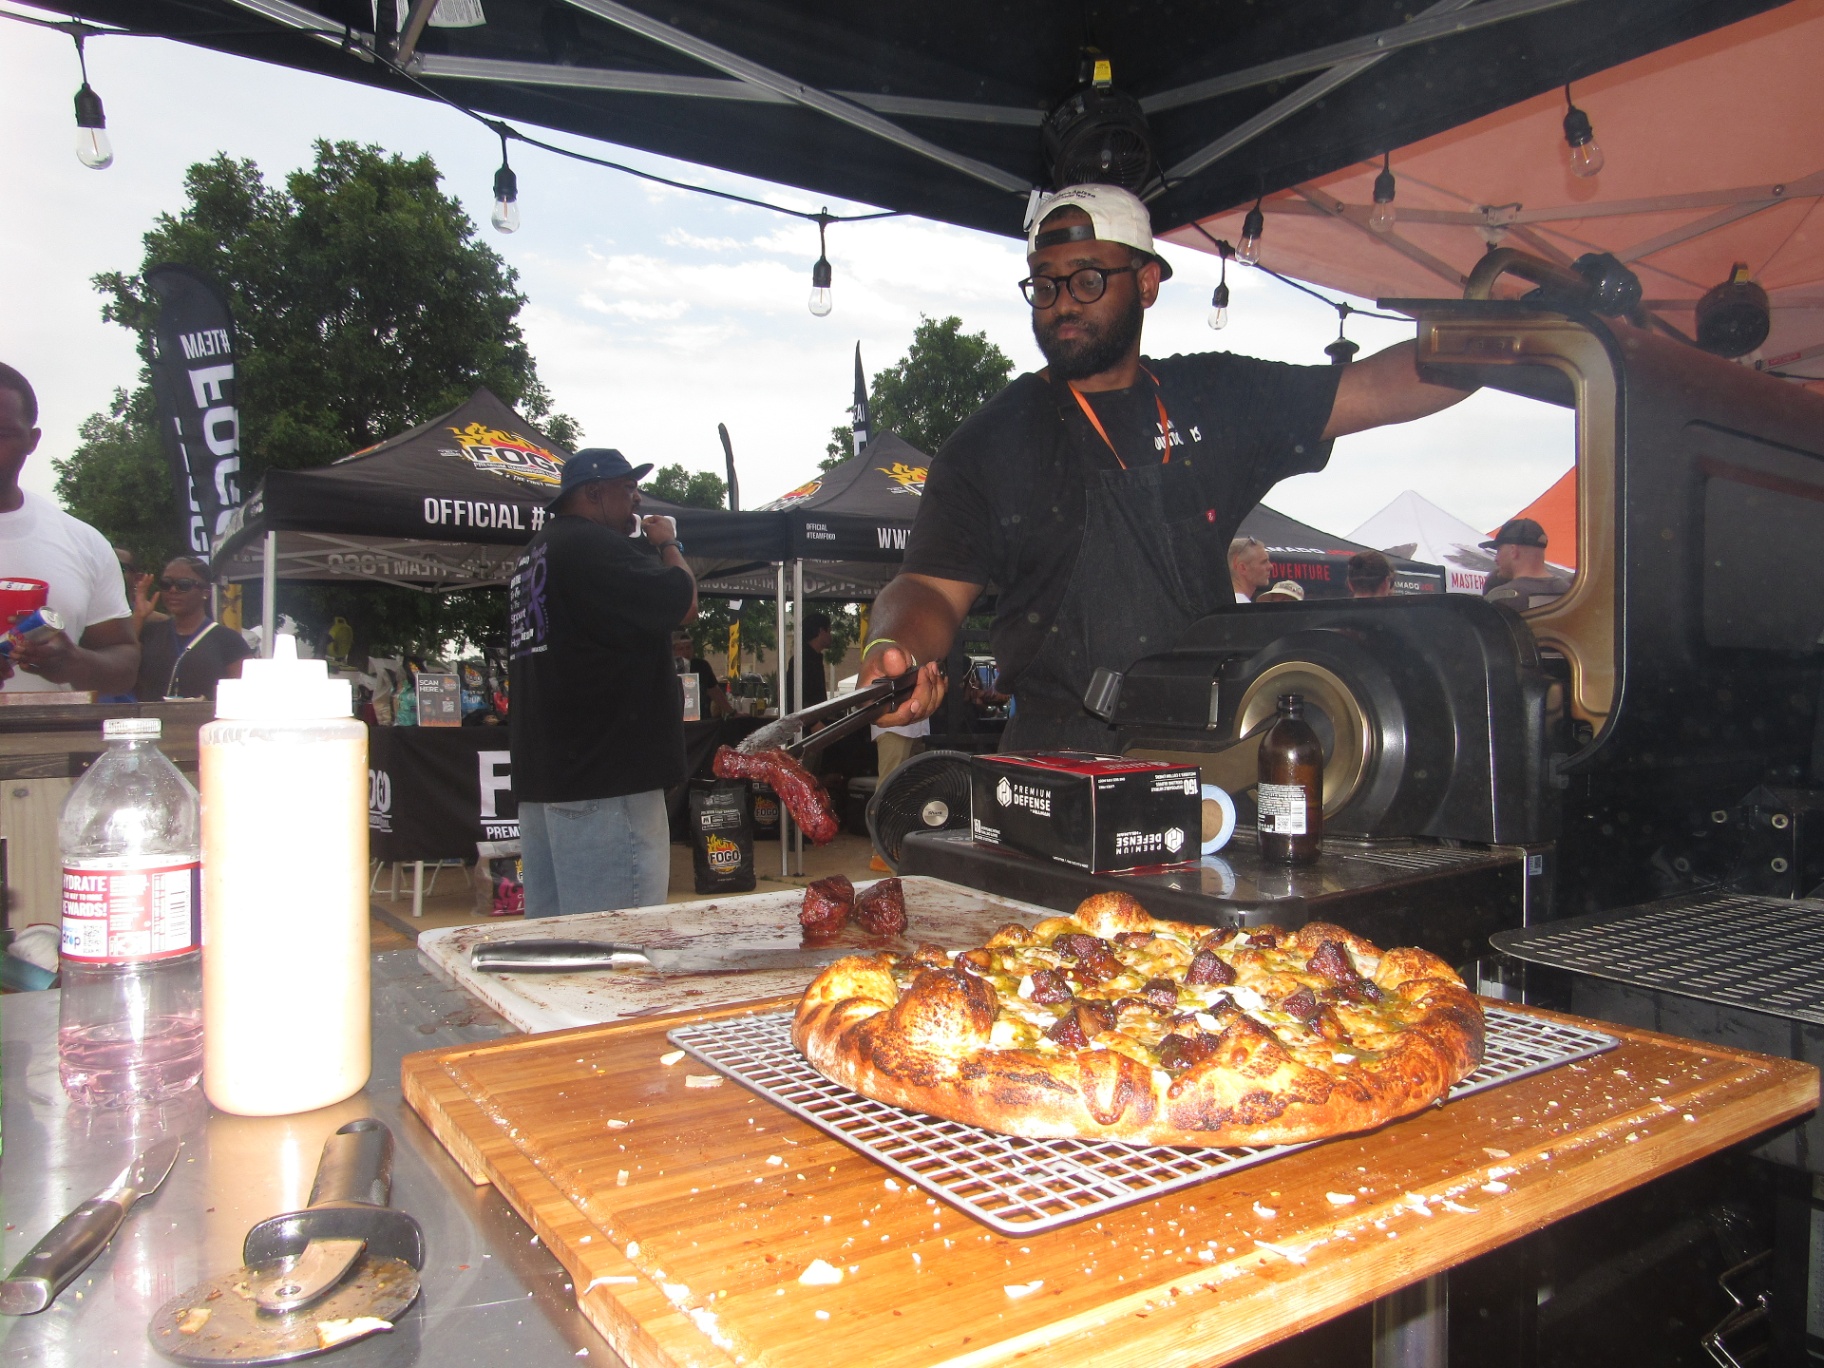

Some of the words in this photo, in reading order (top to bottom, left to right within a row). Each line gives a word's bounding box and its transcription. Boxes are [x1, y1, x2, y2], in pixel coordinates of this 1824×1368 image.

[468, 445, 565, 476] FOG
[424, 498, 525, 530] OFFICIAL
[806, 523, 828, 531] OFFICIAL
[1268, 562, 1331, 581] DVENTURE
[1451, 572, 1489, 590] MASTER
[1014, 784, 1051, 799] PREMIUM
[1184, 779, 1199, 795] 150
[1014, 794, 1051, 811] DEFENSE
[1116, 833, 1162, 847] DEFENSE
[709, 850, 741, 864] FOGO
[1116, 843, 1162, 855] PREMIUM
